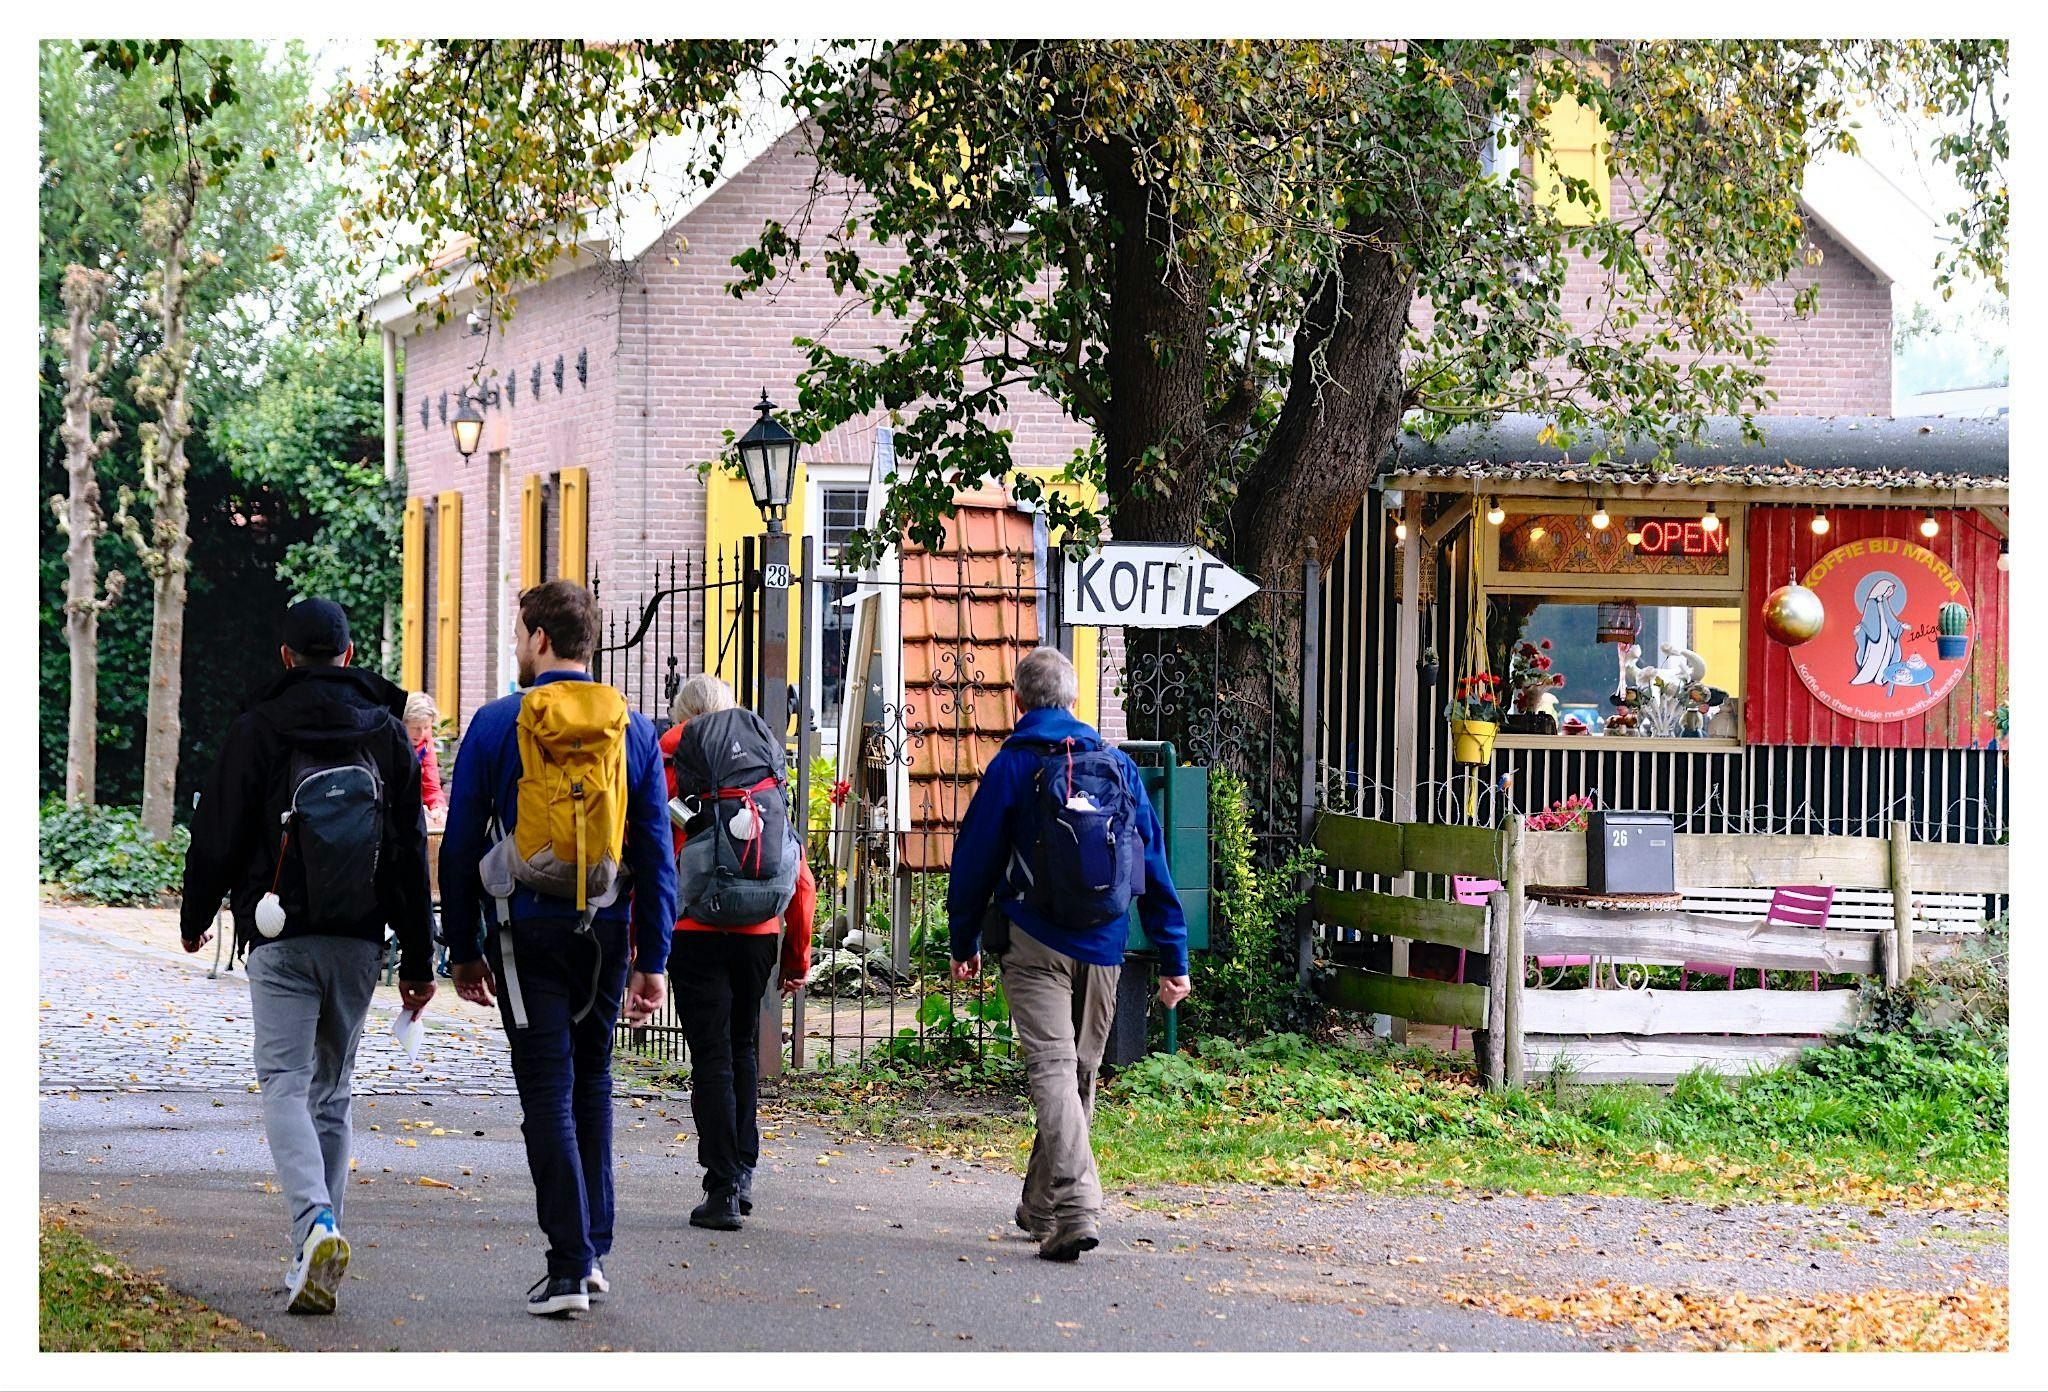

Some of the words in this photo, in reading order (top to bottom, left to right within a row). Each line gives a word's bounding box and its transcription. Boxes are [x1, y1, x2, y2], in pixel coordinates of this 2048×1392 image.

[1640, 521, 1724, 554] OPEN
[767, 565, 787, 587] 28
[1802, 542, 1865, 589] KOFFIE
[1868, 539, 1899, 554] BIJ
[1902, 542, 1961, 597] MARIA
[1798, 663, 1820, 692] Koffie
[1818, 690, 1832, 703] en
[1831, 698, 1854, 713] thee
[1854, 706, 1883, 719] huisje
[1884, 709, 1905, 718] met
[1612, 829, 1628, 847] 26
